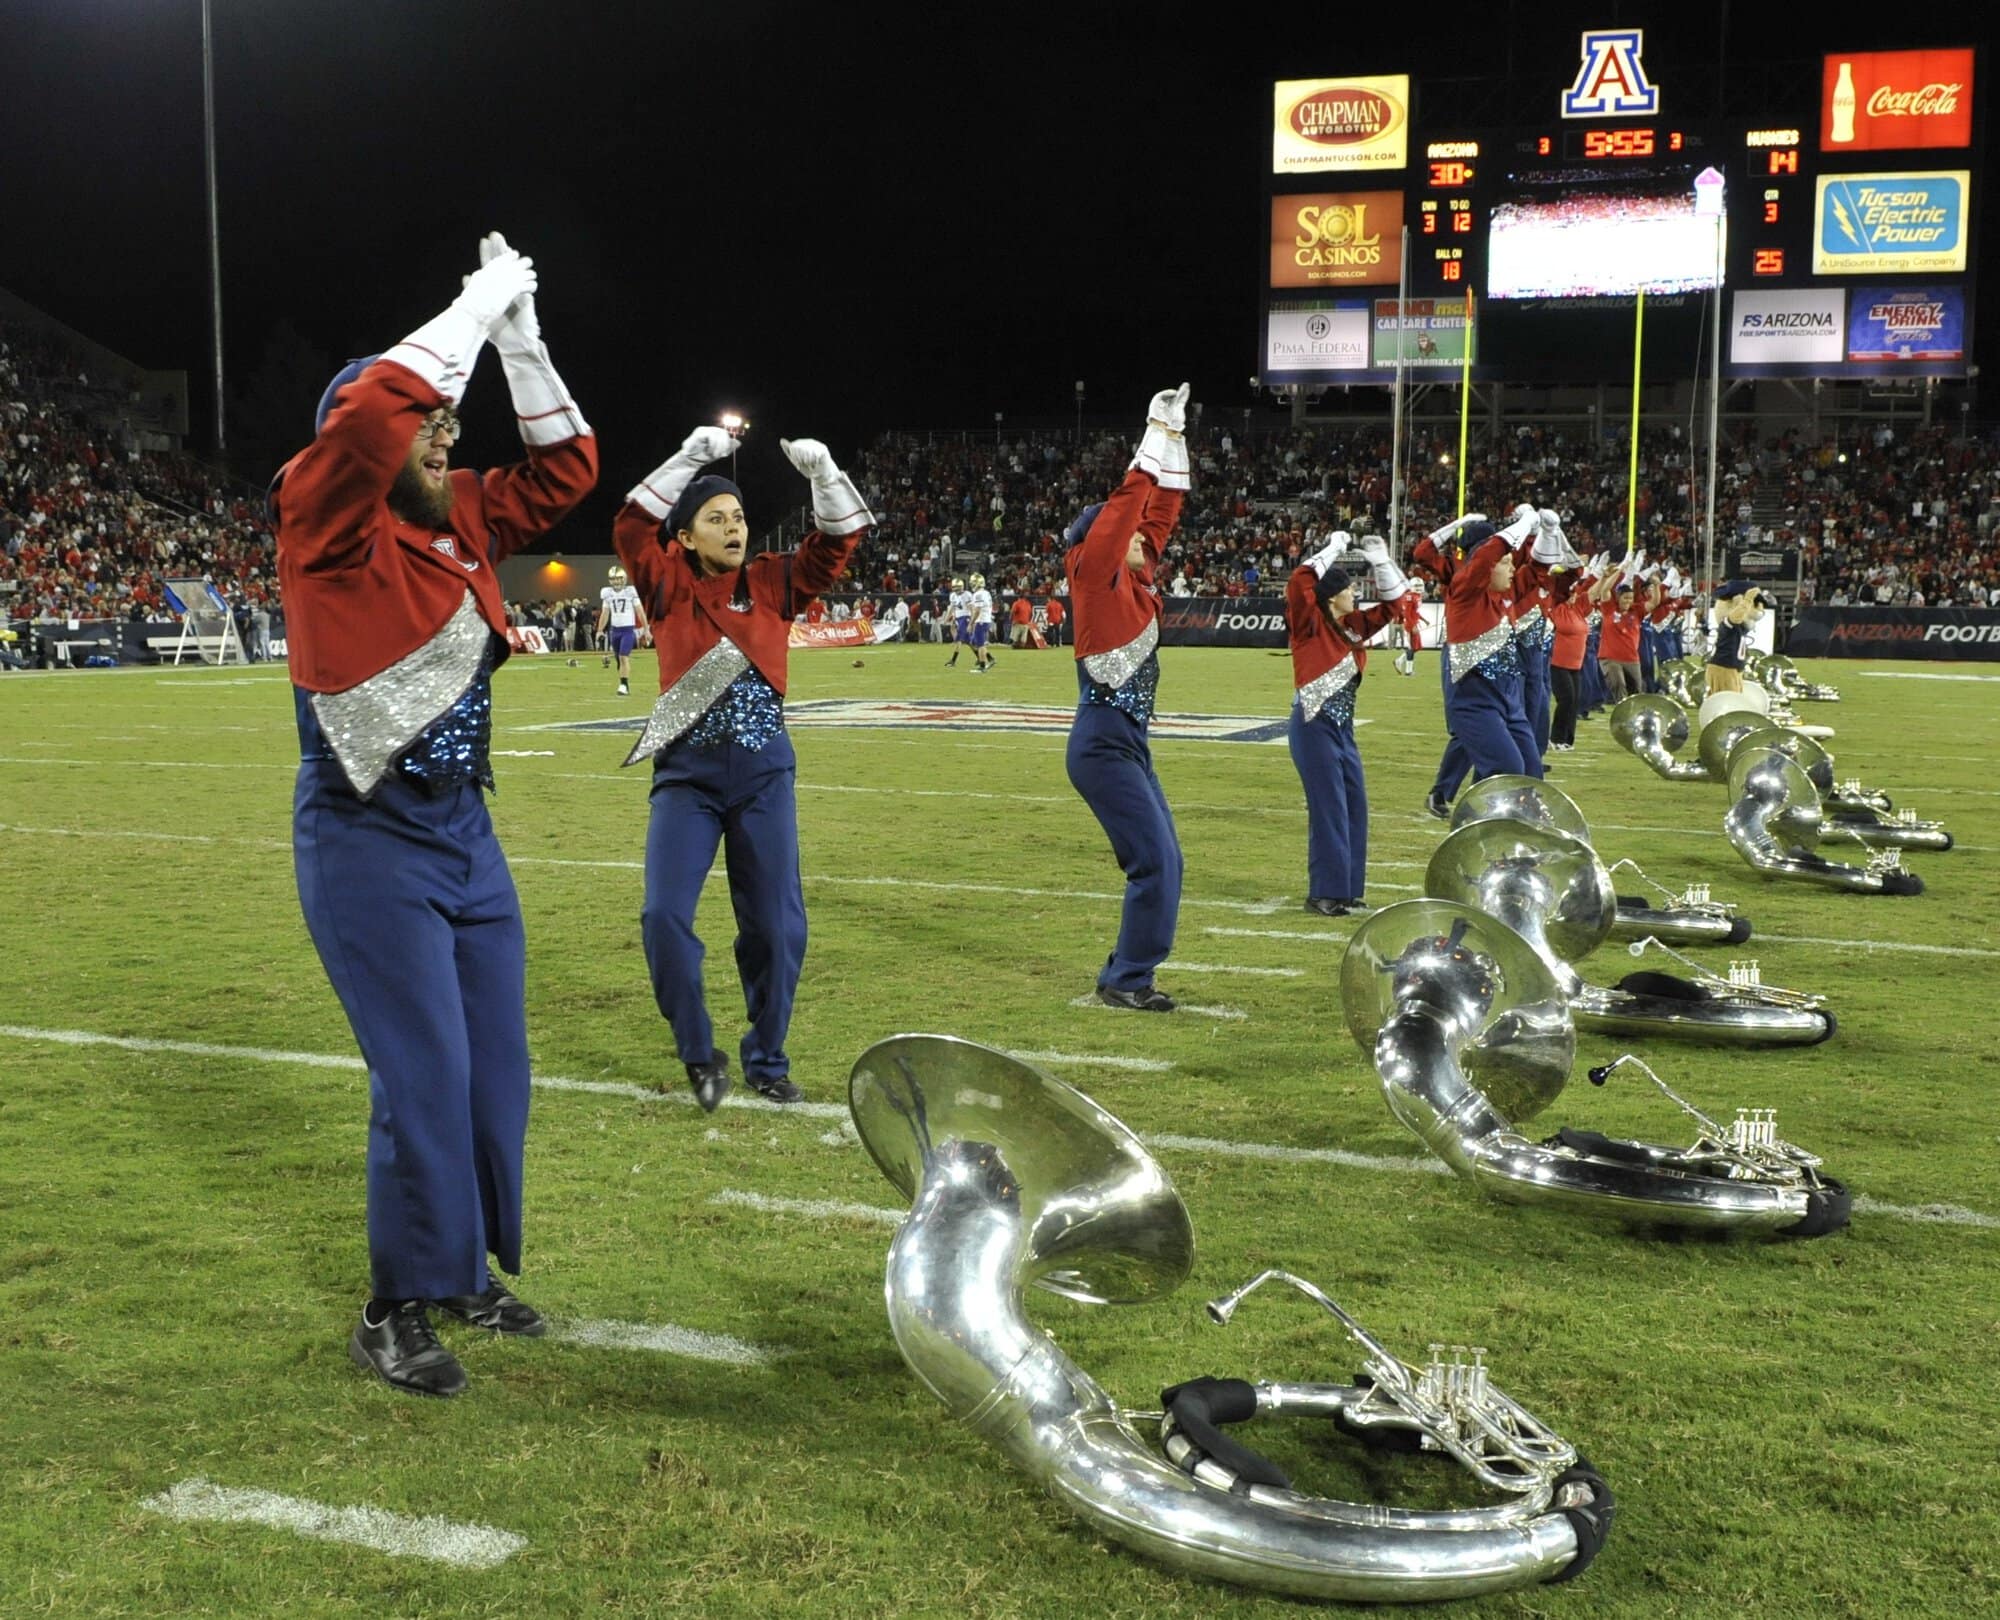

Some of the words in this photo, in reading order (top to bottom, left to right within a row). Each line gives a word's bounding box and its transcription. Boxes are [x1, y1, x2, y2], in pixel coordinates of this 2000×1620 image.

[1561, 29, 1660, 119] A
[1866, 79, 1963, 117] Coca-Cola
[1300, 100, 1382, 125] CHAPMAN
[1301, 123, 1380, 135] AUTOMOTIVE
[1539, 138, 1550, 155] 3
[1585, 129, 1654, 157] 5:55
[1670, 132, 1682, 150] 3
[1283, 152, 1397, 165] CHAPMANTUCSON.COM
[1428, 142, 1478, 158] ARIZONA
[1430, 163, 1464, 185] 30
[1857, 188, 1928, 207] Tucson
[1765, 203, 1778, 222] 3
[1864, 207, 1946, 224] Electric
[1295, 204, 1380, 248] SOL
[1423, 213, 1435, 233] 3
[1453, 213, 1471, 232] 12
[1870, 225, 1946, 243] Power
[1295, 246, 1381, 267] CASINOS
[1755, 251, 1782, 273] 25
[1820, 259, 1827, 268] A
[1829, 256, 1877, 268] UniSource
[1878, 257, 1909, 269] Energy
[1913, 254, 1957, 267] Company
[1308, 271, 1367, 279] SOLCASINOS.COM
[1376, 301, 1434, 316] BRKE
[1543, 297, 1685, 310] ARIZONAWILDCAS.COM
[1871, 304, 1941, 318] ENERGY
[1377, 319, 1398, 330] CAR
[1402, 318, 1428, 329] CARE
[1743, 314, 1762, 328] FS
[1763, 312, 1833, 328] ARIZONA
[1887, 315, 1940, 327] DRINK
[1376, 358, 1473, 368] wwwbrakemax.co
[612, 599, 627, 614] 17
[1215, 614, 1286, 631] FOOTB
[1829, 624, 1926, 641] ARIZONA
